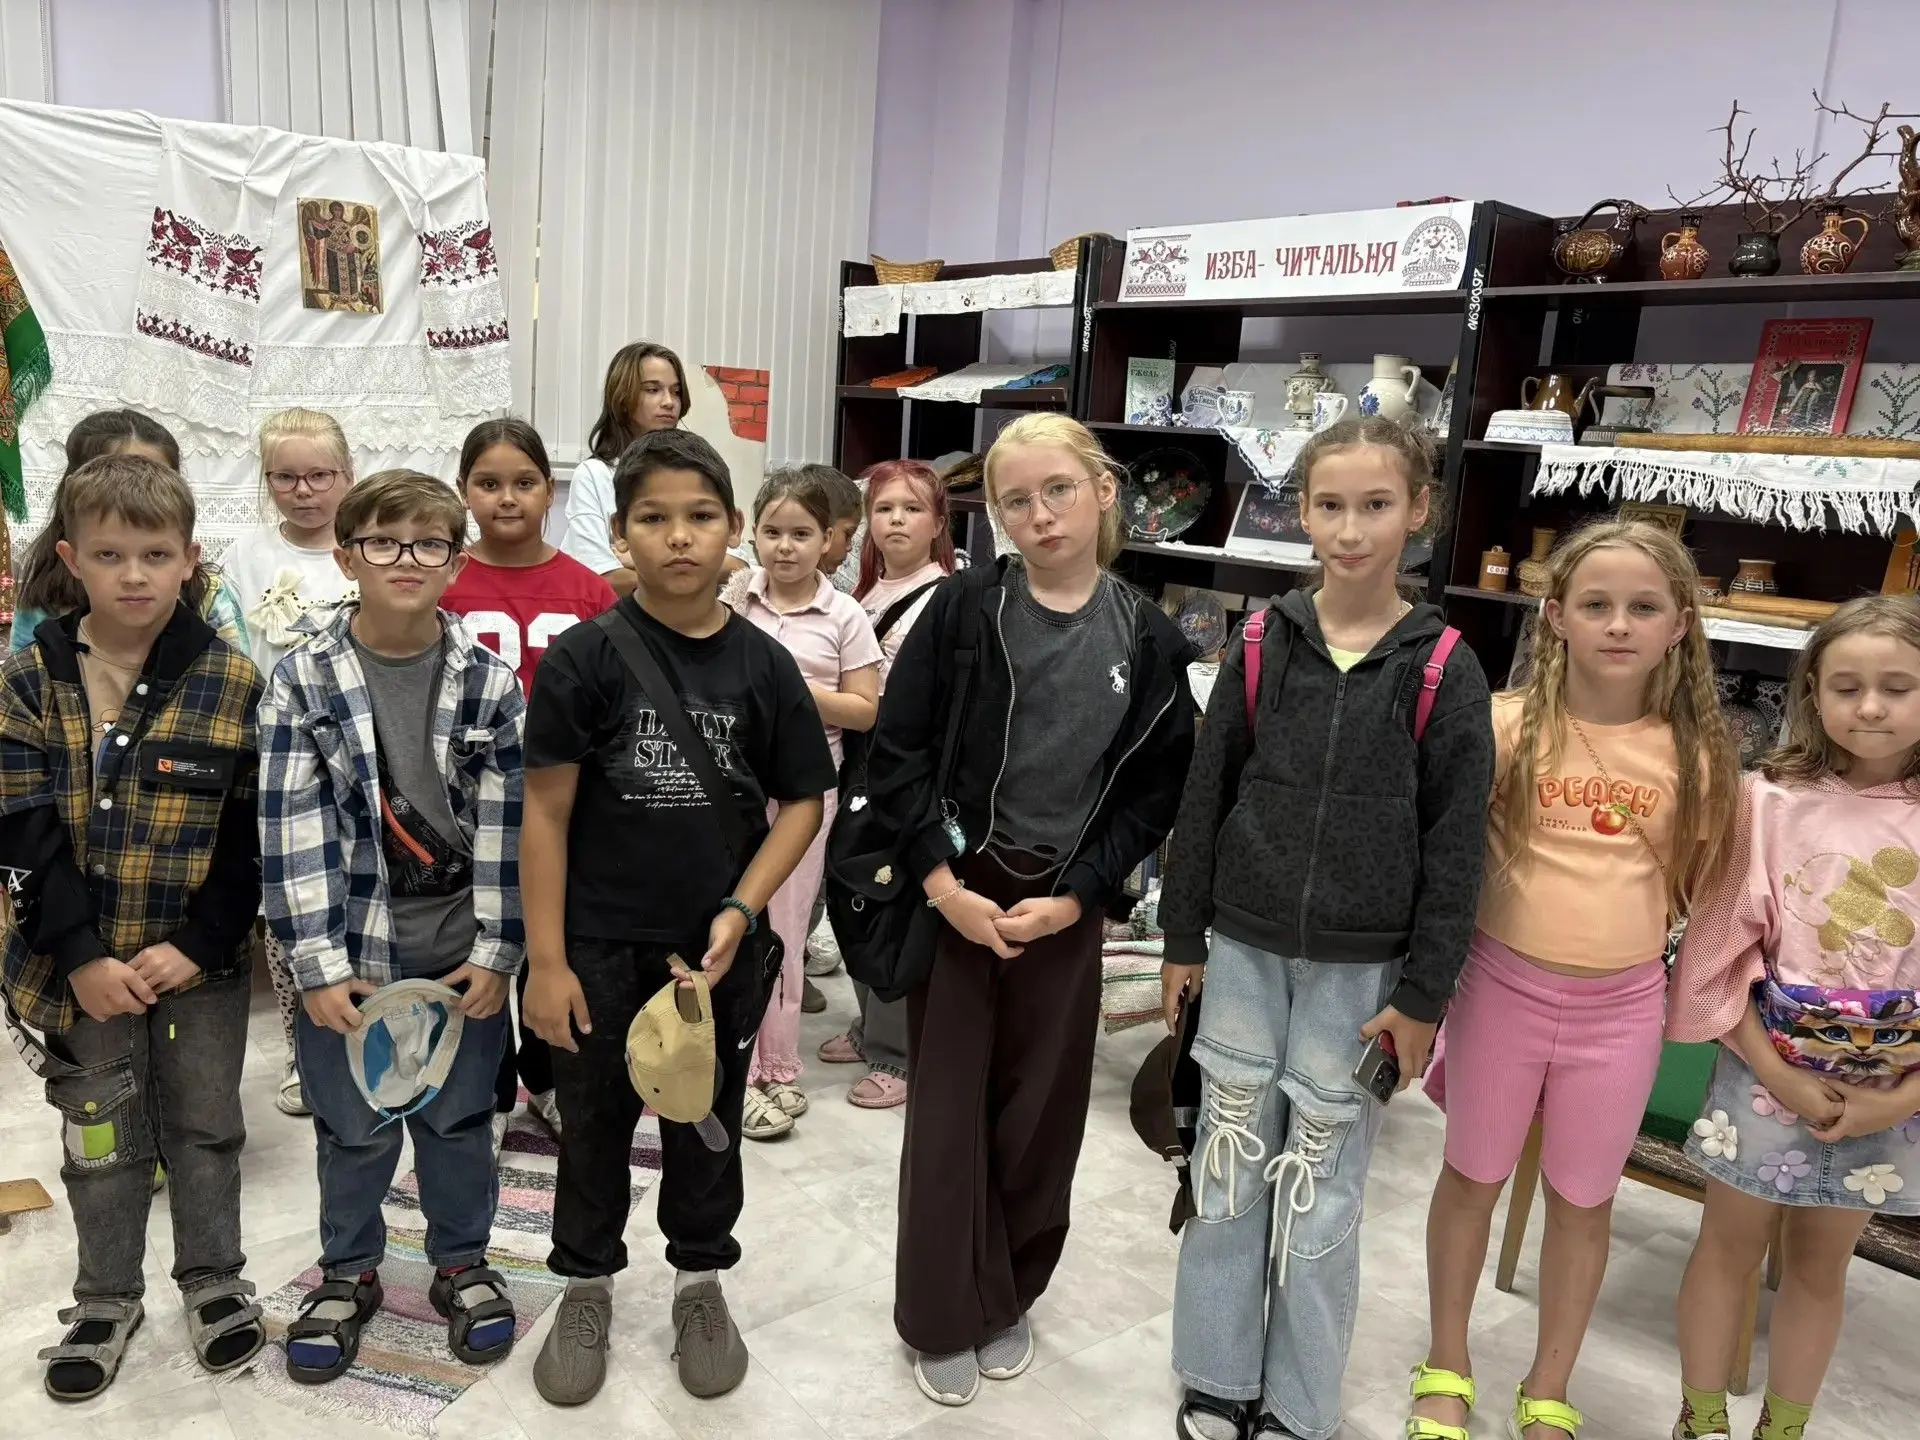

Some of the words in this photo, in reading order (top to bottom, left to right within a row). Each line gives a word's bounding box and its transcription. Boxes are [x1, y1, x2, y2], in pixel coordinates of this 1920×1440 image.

[1205, 250, 1265, 280] ИЗБА-
[1276, 241, 1398, 277] ЧИТАЛЬНЯ
[1467, 267, 1484, 331] 01630097
[1538, 776, 1661, 818] PEACH
